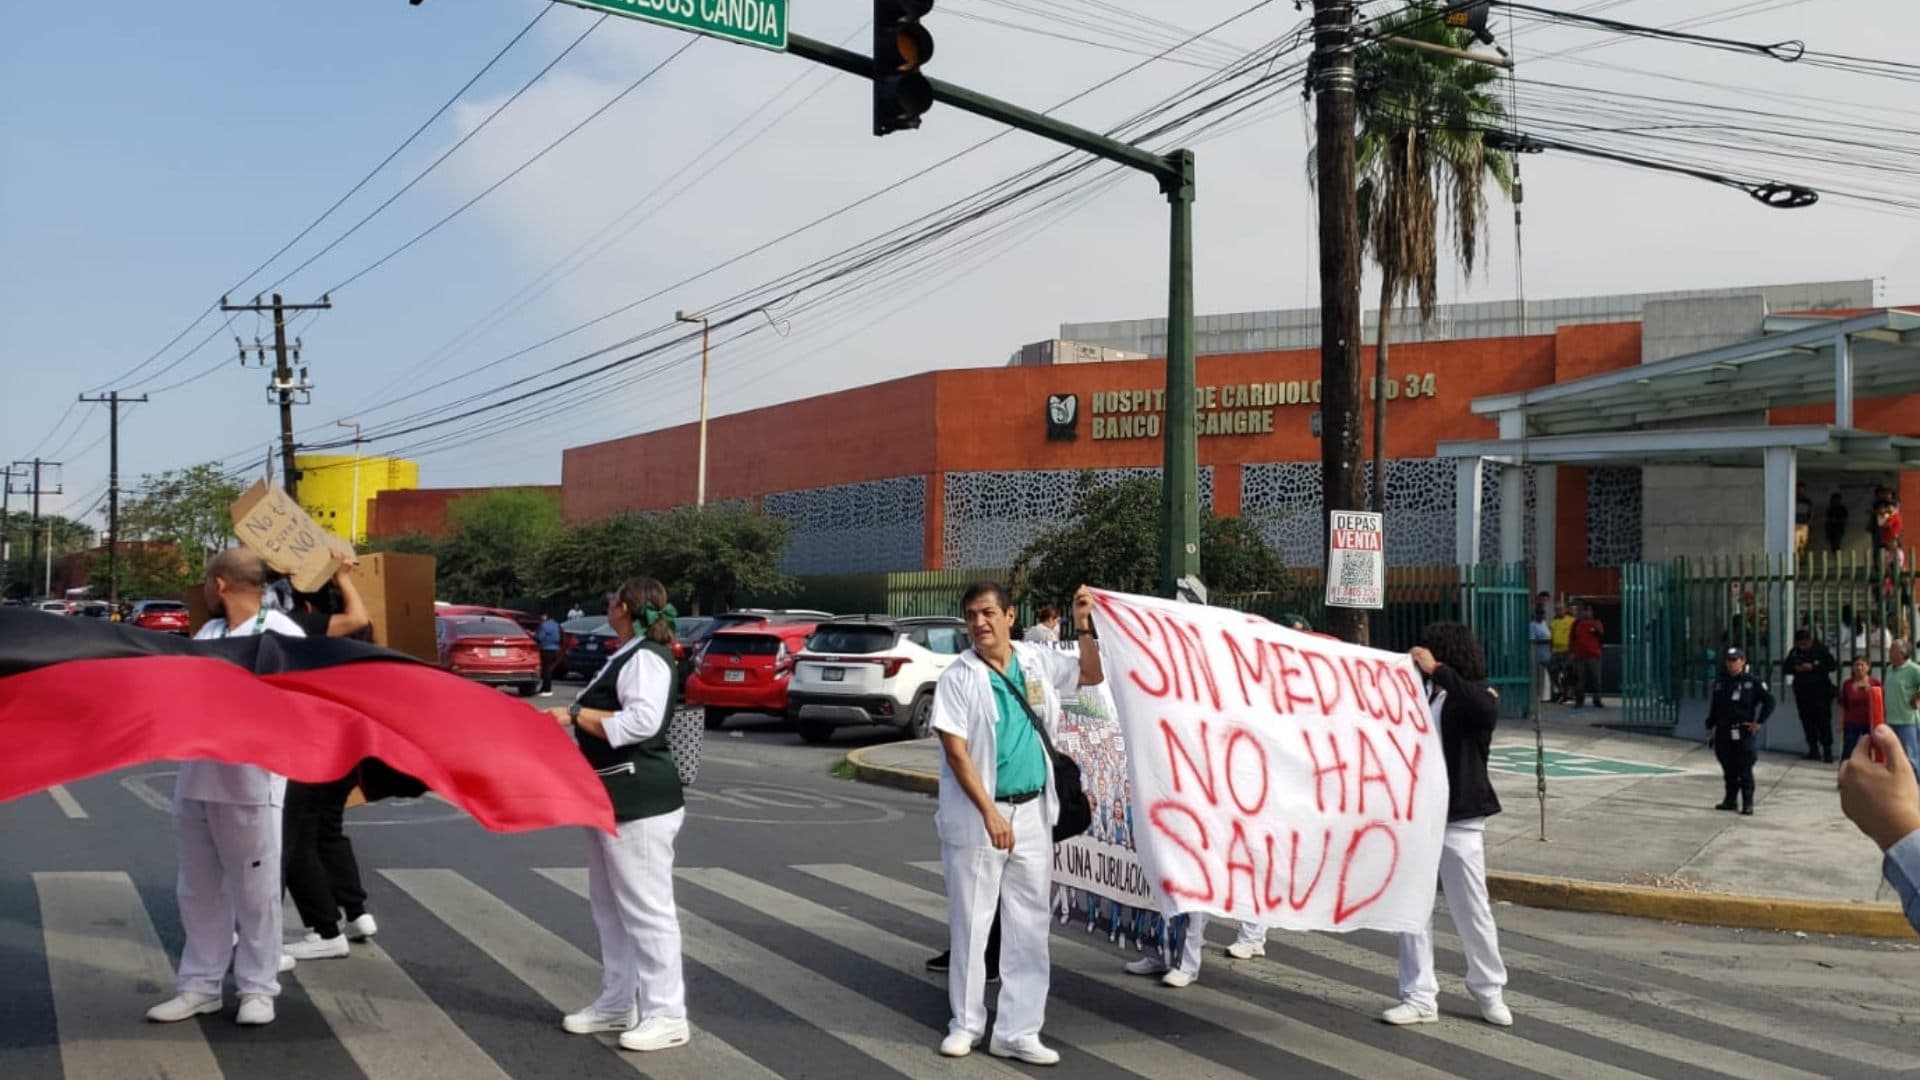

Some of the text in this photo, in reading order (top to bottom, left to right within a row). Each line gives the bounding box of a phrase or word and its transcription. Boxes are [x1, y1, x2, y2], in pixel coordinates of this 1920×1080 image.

[700, 0, 778, 38] CANDIA
[1092, 388, 1166, 414] HOSPIT
[1221, 380, 1322, 408] CARDIOLO
[1404, 372, 1436, 398] 34
[1092, 410, 1274, 440] BANCO SANGRE
[1336, 531, 1378, 549] VENTA
[1337, 516, 1376, 531] DEPAS
[1092, 588, 1429, 733] SIN MEDICOS
[1160, 719, 1422, 821] NO HAY
[1066, 843, 1092, 880] UNA
[1149, 801, 1399, 925] SALUD
